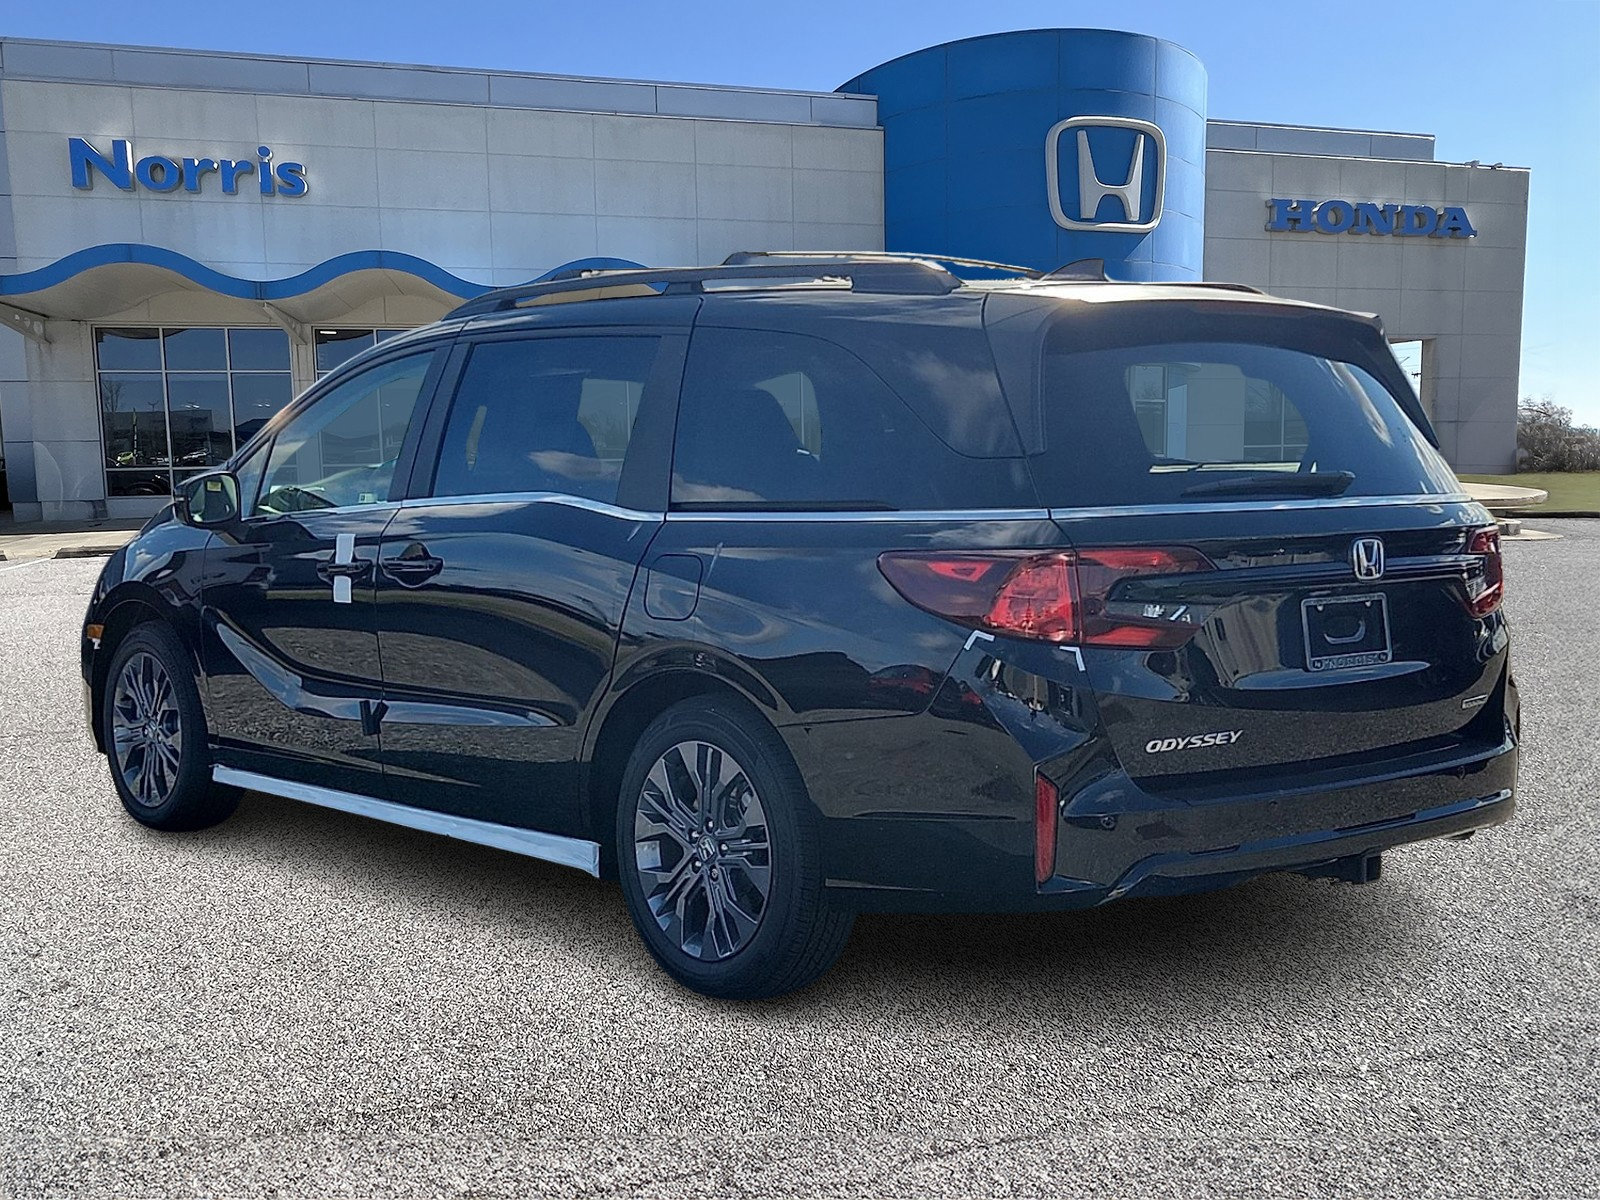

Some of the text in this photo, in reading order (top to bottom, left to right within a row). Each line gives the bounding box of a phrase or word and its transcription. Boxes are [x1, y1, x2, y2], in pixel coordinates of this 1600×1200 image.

[68, 137, 309, 197] Norris
[1265, 198, 1478, 239] HONDA
[1145, 729, 1244, 754] ODYSSEY
